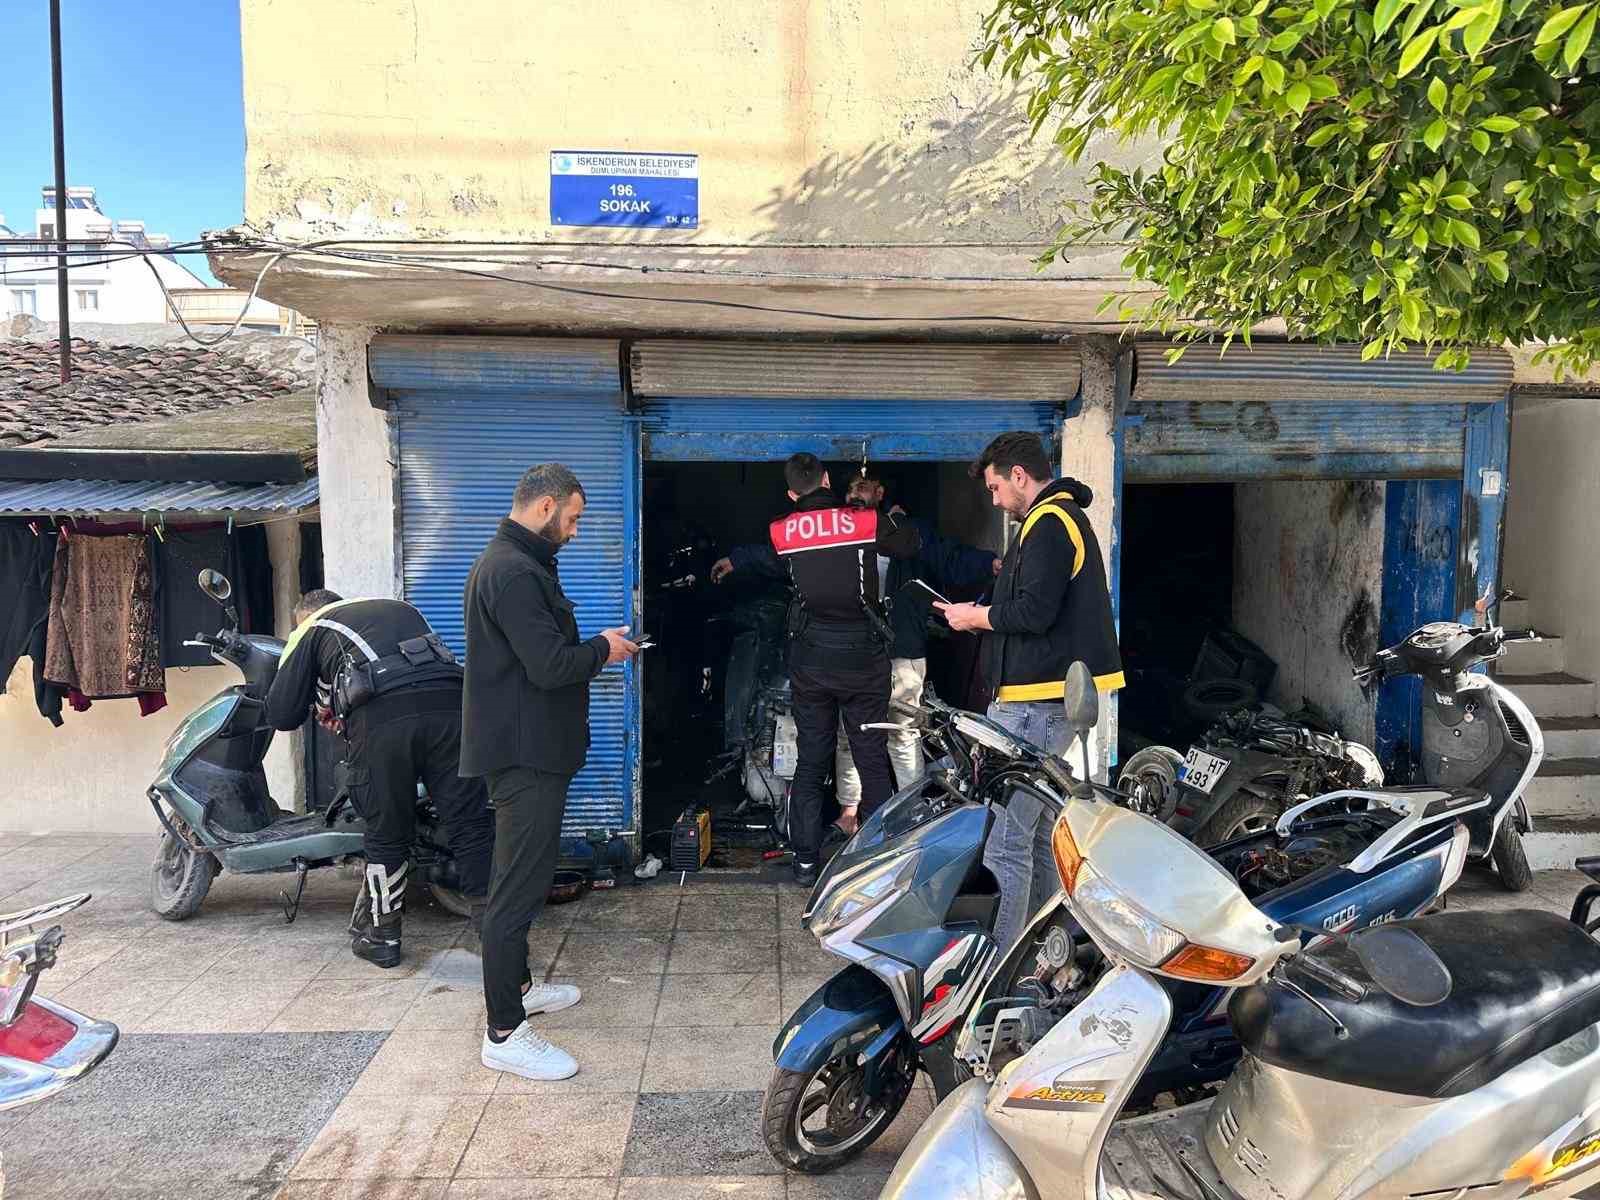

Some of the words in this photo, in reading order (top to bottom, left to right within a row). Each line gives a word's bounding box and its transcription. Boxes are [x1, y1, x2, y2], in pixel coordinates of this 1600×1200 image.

[577, 155, 637, 166] İSKENDERUN
[639, 158, 693, 168] BELEDİYESİ
[609, 184, 637, 197] 196.
[600, 199, 650, 213] SOKAK
[785, 508, 855, 542] POLİS
[1187, 750, 1198, 766] 31
[1208, 758, 1226, 775] HT
[1187, 769, 1209, 788] 493
[1024, 1087, 1105, 1104] Activa
